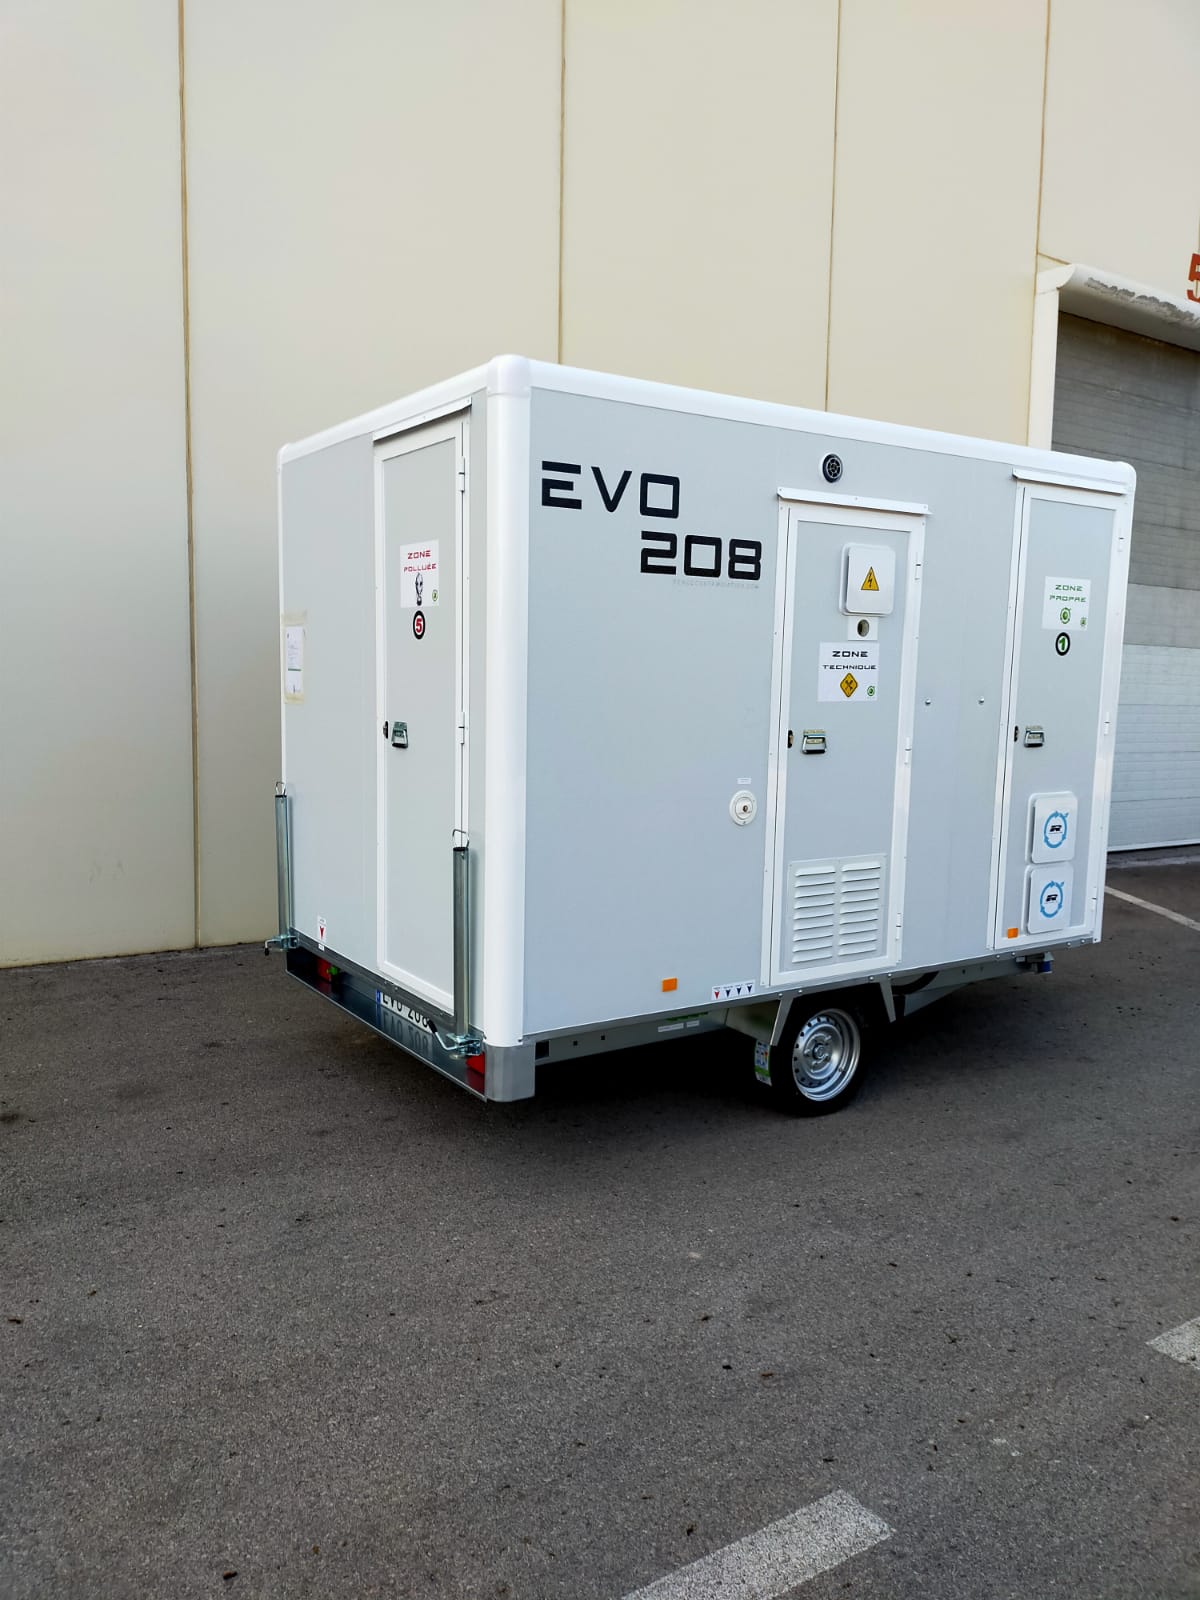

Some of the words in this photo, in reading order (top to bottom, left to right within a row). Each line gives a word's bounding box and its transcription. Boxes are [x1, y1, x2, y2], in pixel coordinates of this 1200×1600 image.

[542, 461, 680, 518] EVO
[407, 550, 431, 559] ZONE
[640, 531, 762, 580] 208
[1055, 584, 1083, 592] ZONE
[415, 618, 422, 633] 5
[1059, 637, 1065, 651] 1
[832, 650, 868, 658] ZONE
